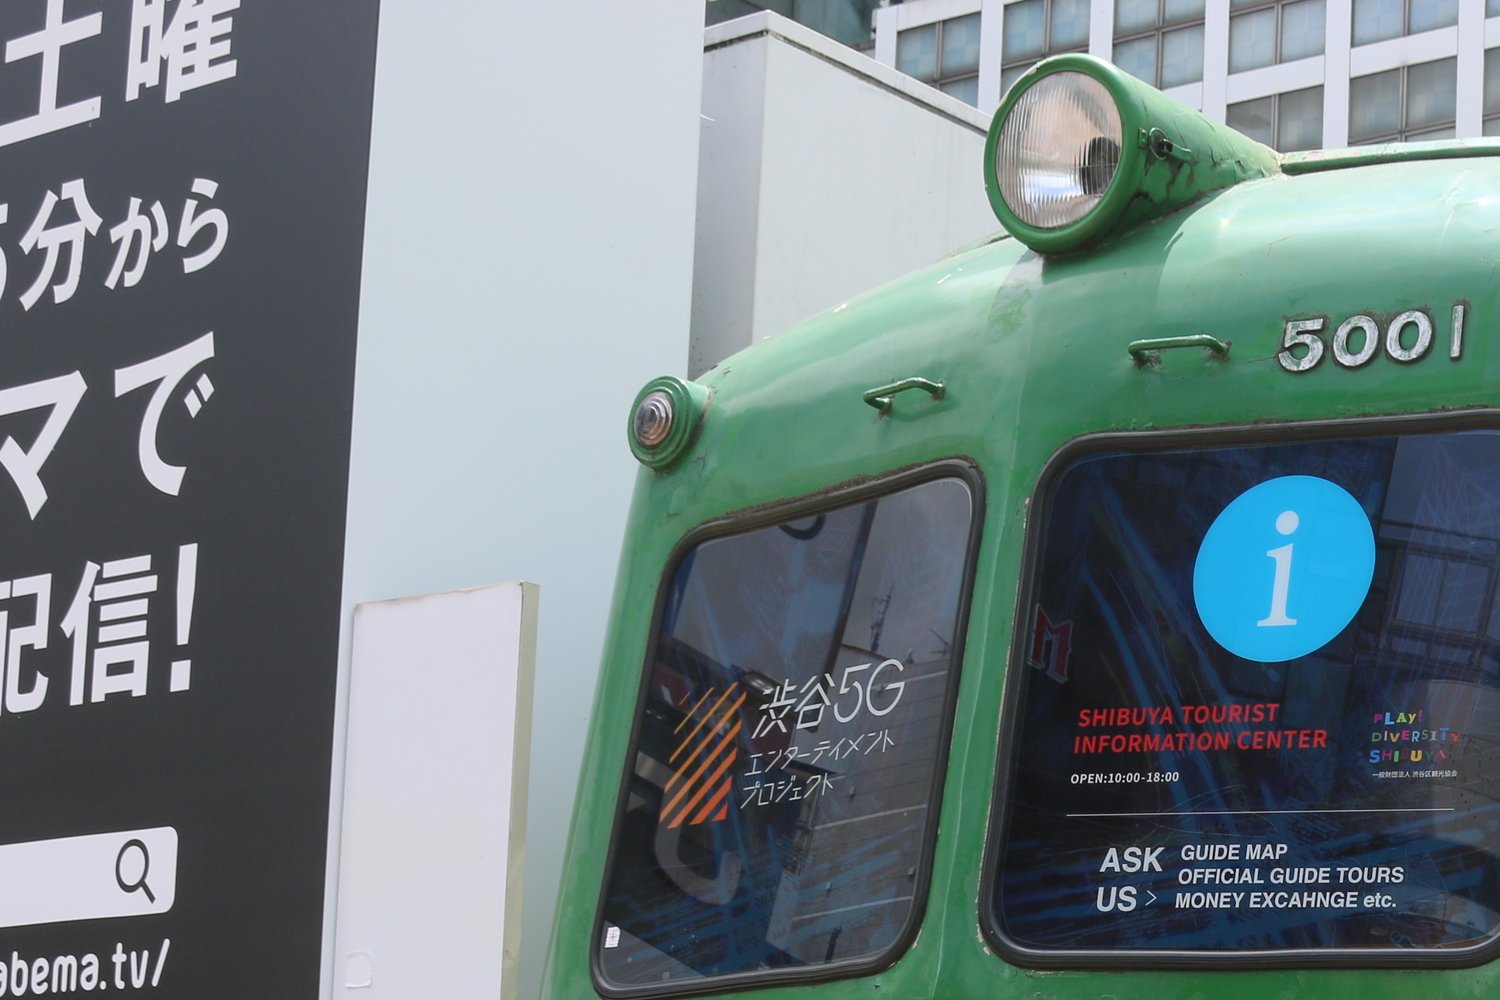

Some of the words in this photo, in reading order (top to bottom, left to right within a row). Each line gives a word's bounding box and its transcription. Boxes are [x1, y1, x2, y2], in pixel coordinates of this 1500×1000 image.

[0, 178, 229, 312] 分から
[1278, 304, 1464, 372] 5001
[751, 658, 905, 740] 渋谷5G
[1077, 706, 1174, 728] SHIBUYA
[1181, 703, 1280, 725] TOURIST
[1073, 731, 1230, 755] INFORMATION
[1236, 729, 1328, 750] CENTER
[1371, 727, 1461, 742] DIVERSITY
[1368, 748, 1450, 764] SHIBUYA
[1070, 771, 1180, 784] OPEN:10:00-18:00
[740, 772, 833, 809] プロジェクト
[1099, 847, 1166, 873] ASK
[1180, 845, 1241, 861] GUIDE
[1245, 844, 1288, 860] MAP
[1178, 868, 1265, 885] OFFICIAL
[1269, 867, 1331, 884] GUIDE
[1336, 866, 1405, 884] TOURS
[1095, 885, 1138, 912] US
[1175, 892, 1244, 909] MONEY
[1249, 892, 1359, 908] EXCAHNGE
[1363, 891, 1397, 908] etc.
